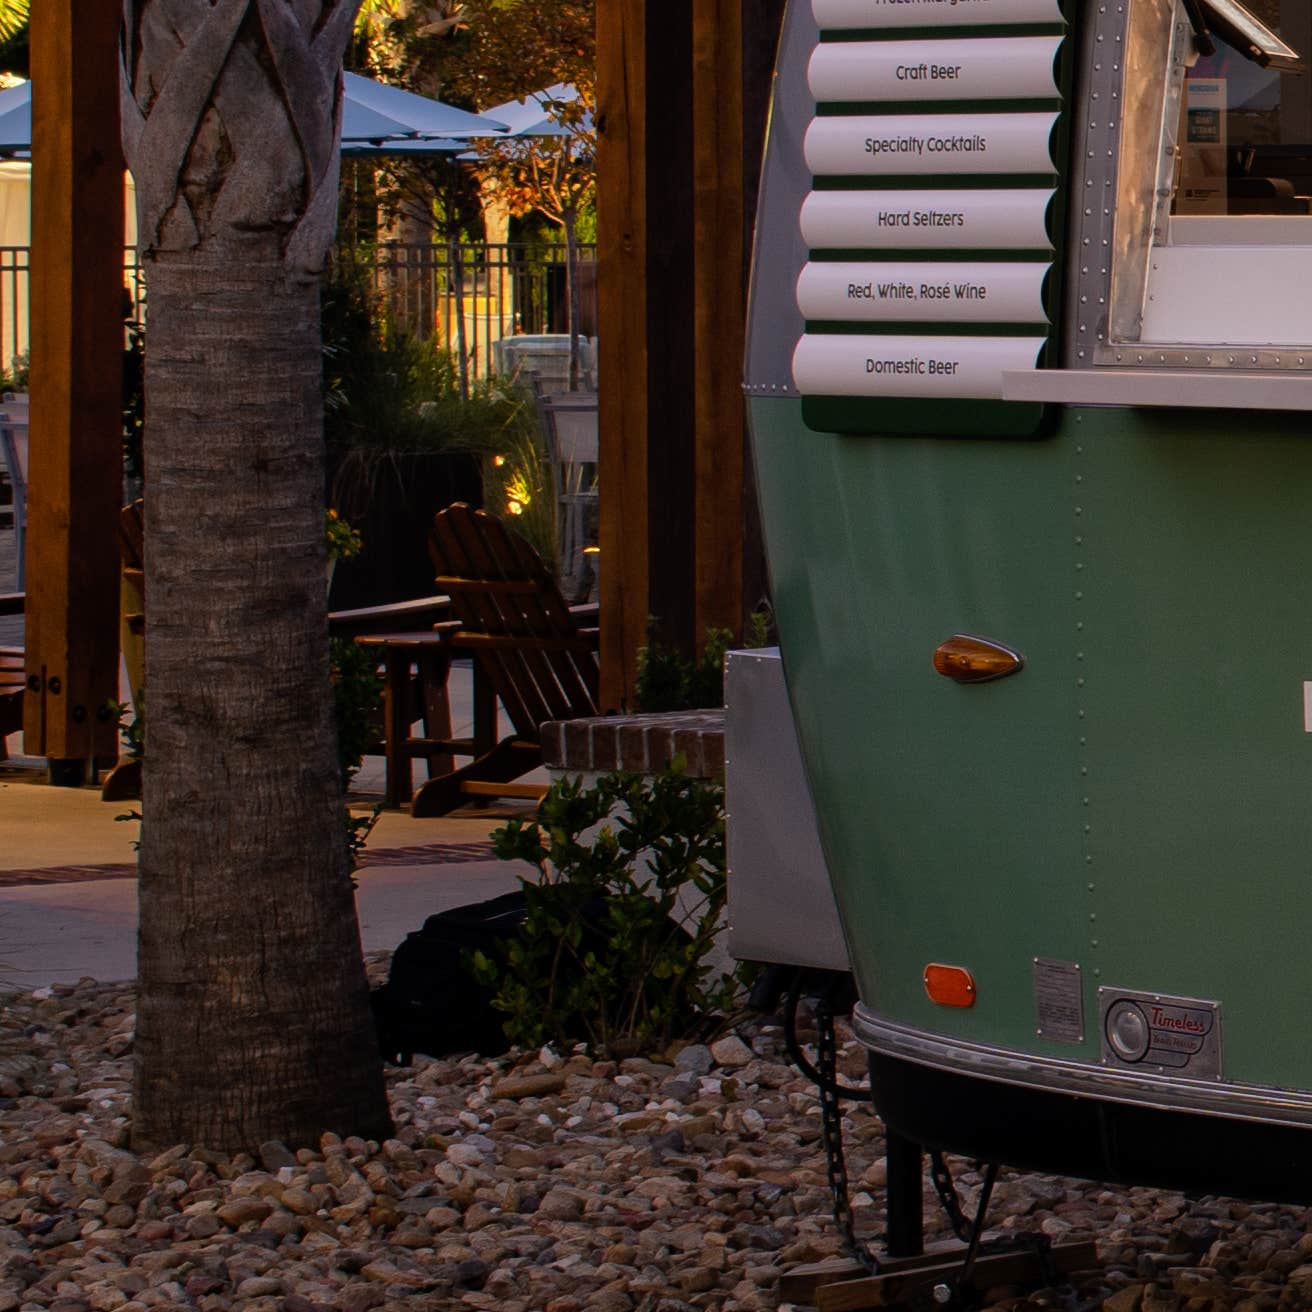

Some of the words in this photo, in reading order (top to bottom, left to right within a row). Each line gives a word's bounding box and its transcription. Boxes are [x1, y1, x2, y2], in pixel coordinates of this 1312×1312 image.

[895, 64, 928, 80] Craft
[930, 64, 961, 80] Beer
[864, 136, 924, 155] Specialty
[926, 134, 986, 152] Cocktails
[878, 211, 910, 227] Hard
[912, 211, 964, 227] Seltzers
[847, 283, 875, 300] Red,
[877, 282, 917, 300] White,
[919, 282, 951, 299] Rosé
[953, 282, 987, 299] Wine
[866, 357, 926, 374] Domestic
[928, 360, 959, 375] Beer
[1151, 1007, 1205, 1032] Timeless
